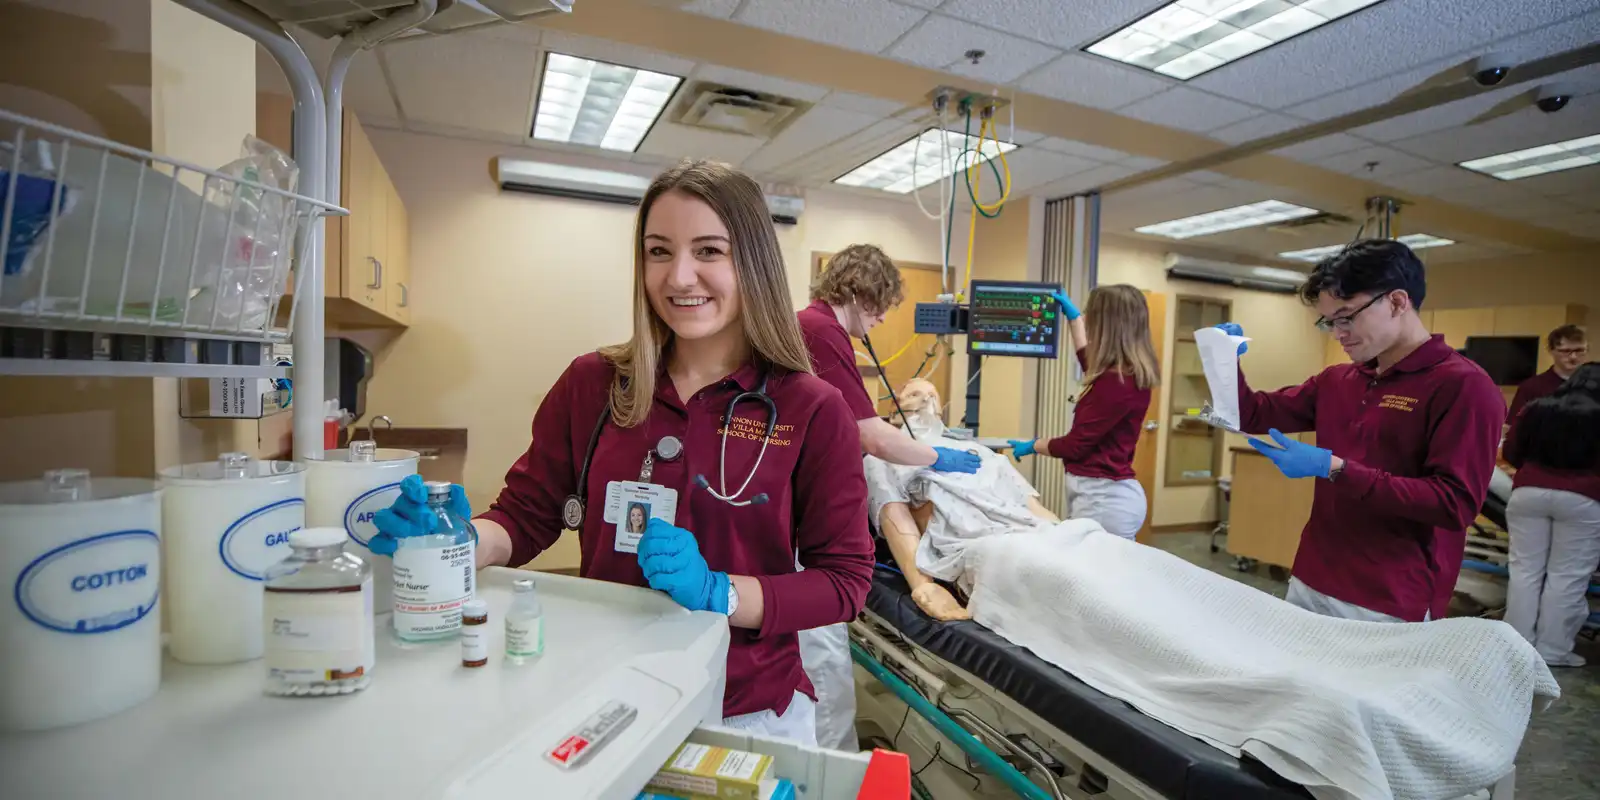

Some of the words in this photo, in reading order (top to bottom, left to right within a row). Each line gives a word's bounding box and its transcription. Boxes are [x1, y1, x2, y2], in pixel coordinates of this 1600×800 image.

[719, 415, 752, 425] GNNON
[753, 420, 795, 432] UNIRSITY
[733, 423, 754, 433] VILLA
[755, 429, 779, 438] MAIA
[748, 433, 759, 441] OF
[356, 511, 375, 523] AP
[70, 563, 148, 592] COTTON
[406, 582, 430, 591] Nurse
